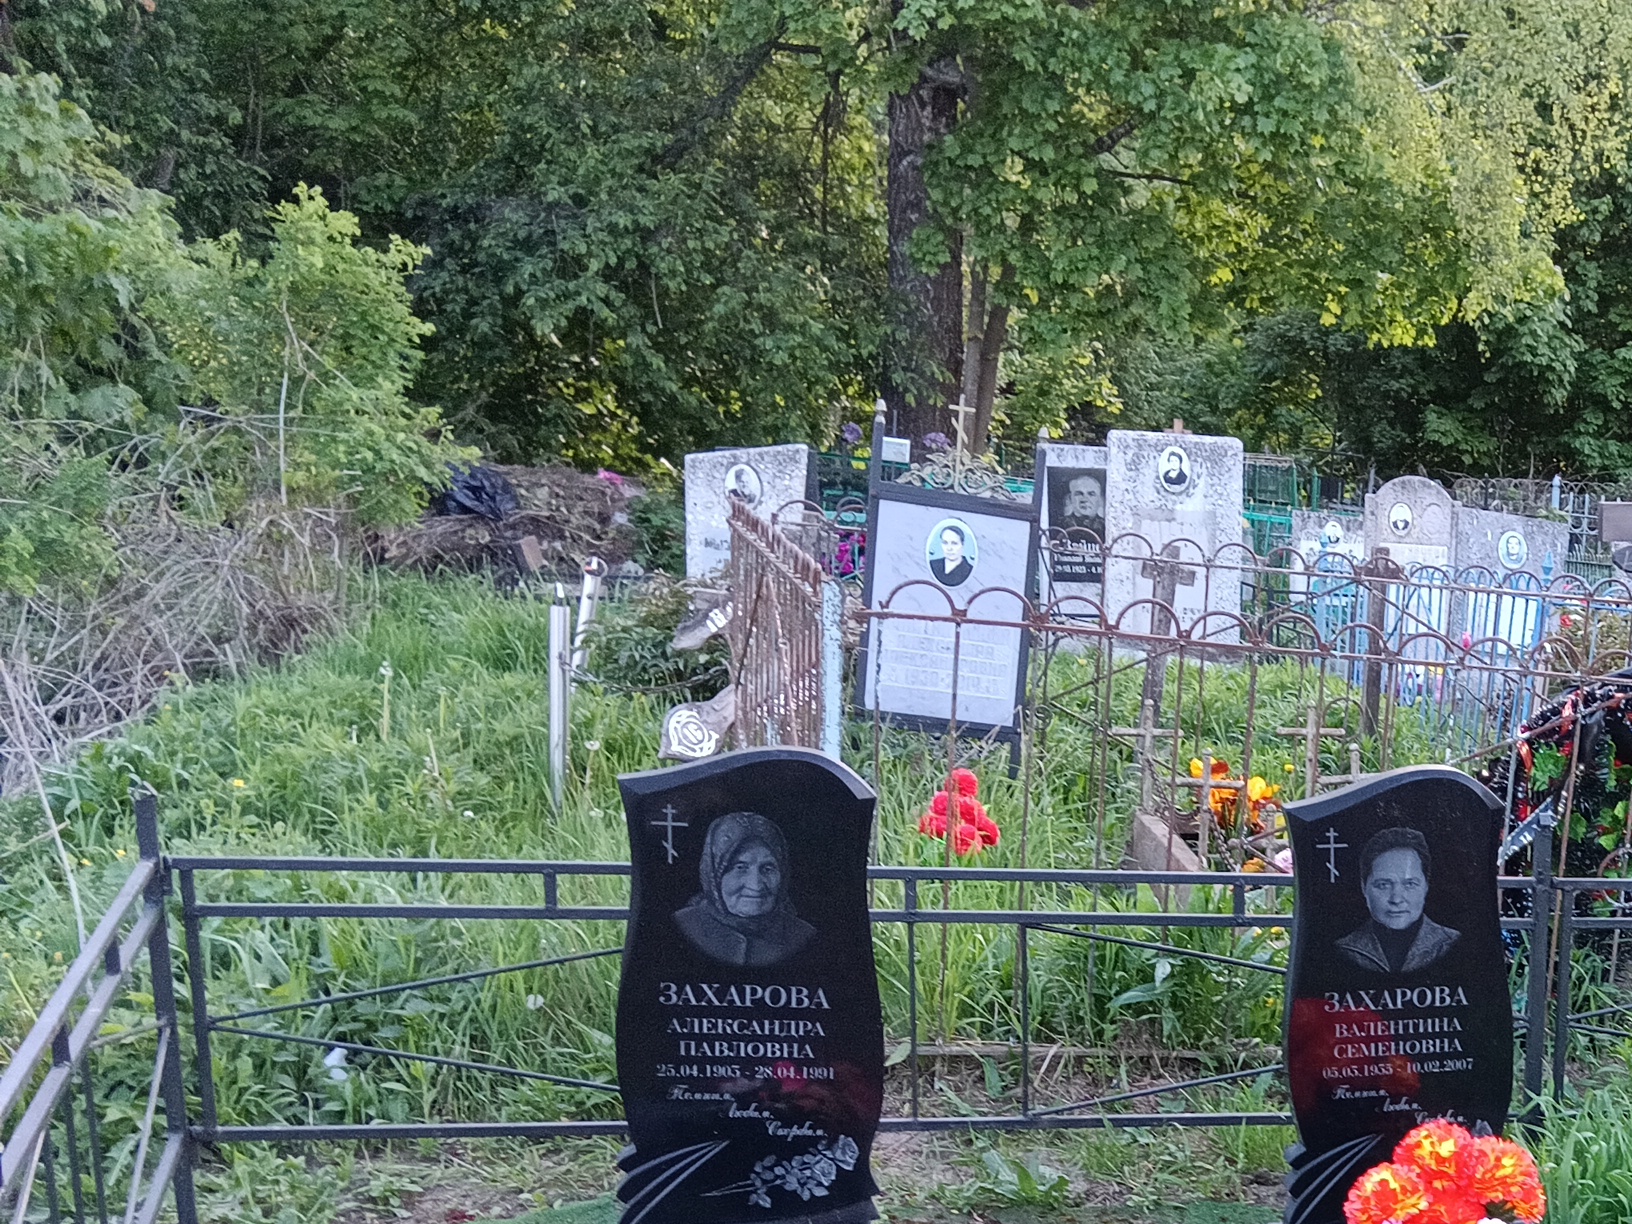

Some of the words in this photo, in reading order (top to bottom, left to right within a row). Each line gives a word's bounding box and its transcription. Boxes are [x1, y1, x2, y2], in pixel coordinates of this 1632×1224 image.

[658, 981, 832, 1010] ЗАХАРОВА
[1323, 985, 1469, 1013] ЗАХАРОВА
[667, 1017, 826, 1038] АЛЕКСАНДРА
[1334, 1016, 1463, 1039] ВАЛЕНТИНА
[679, 1040, 815, 1058] ПАВЛОВНА
[1333, 1037, 1463, 1060] СЕМЕНОВНА
[754, 1065, 836, 1080] 28.04.1991
[1406, 1057, 1474, 1075] 10.02.2007
